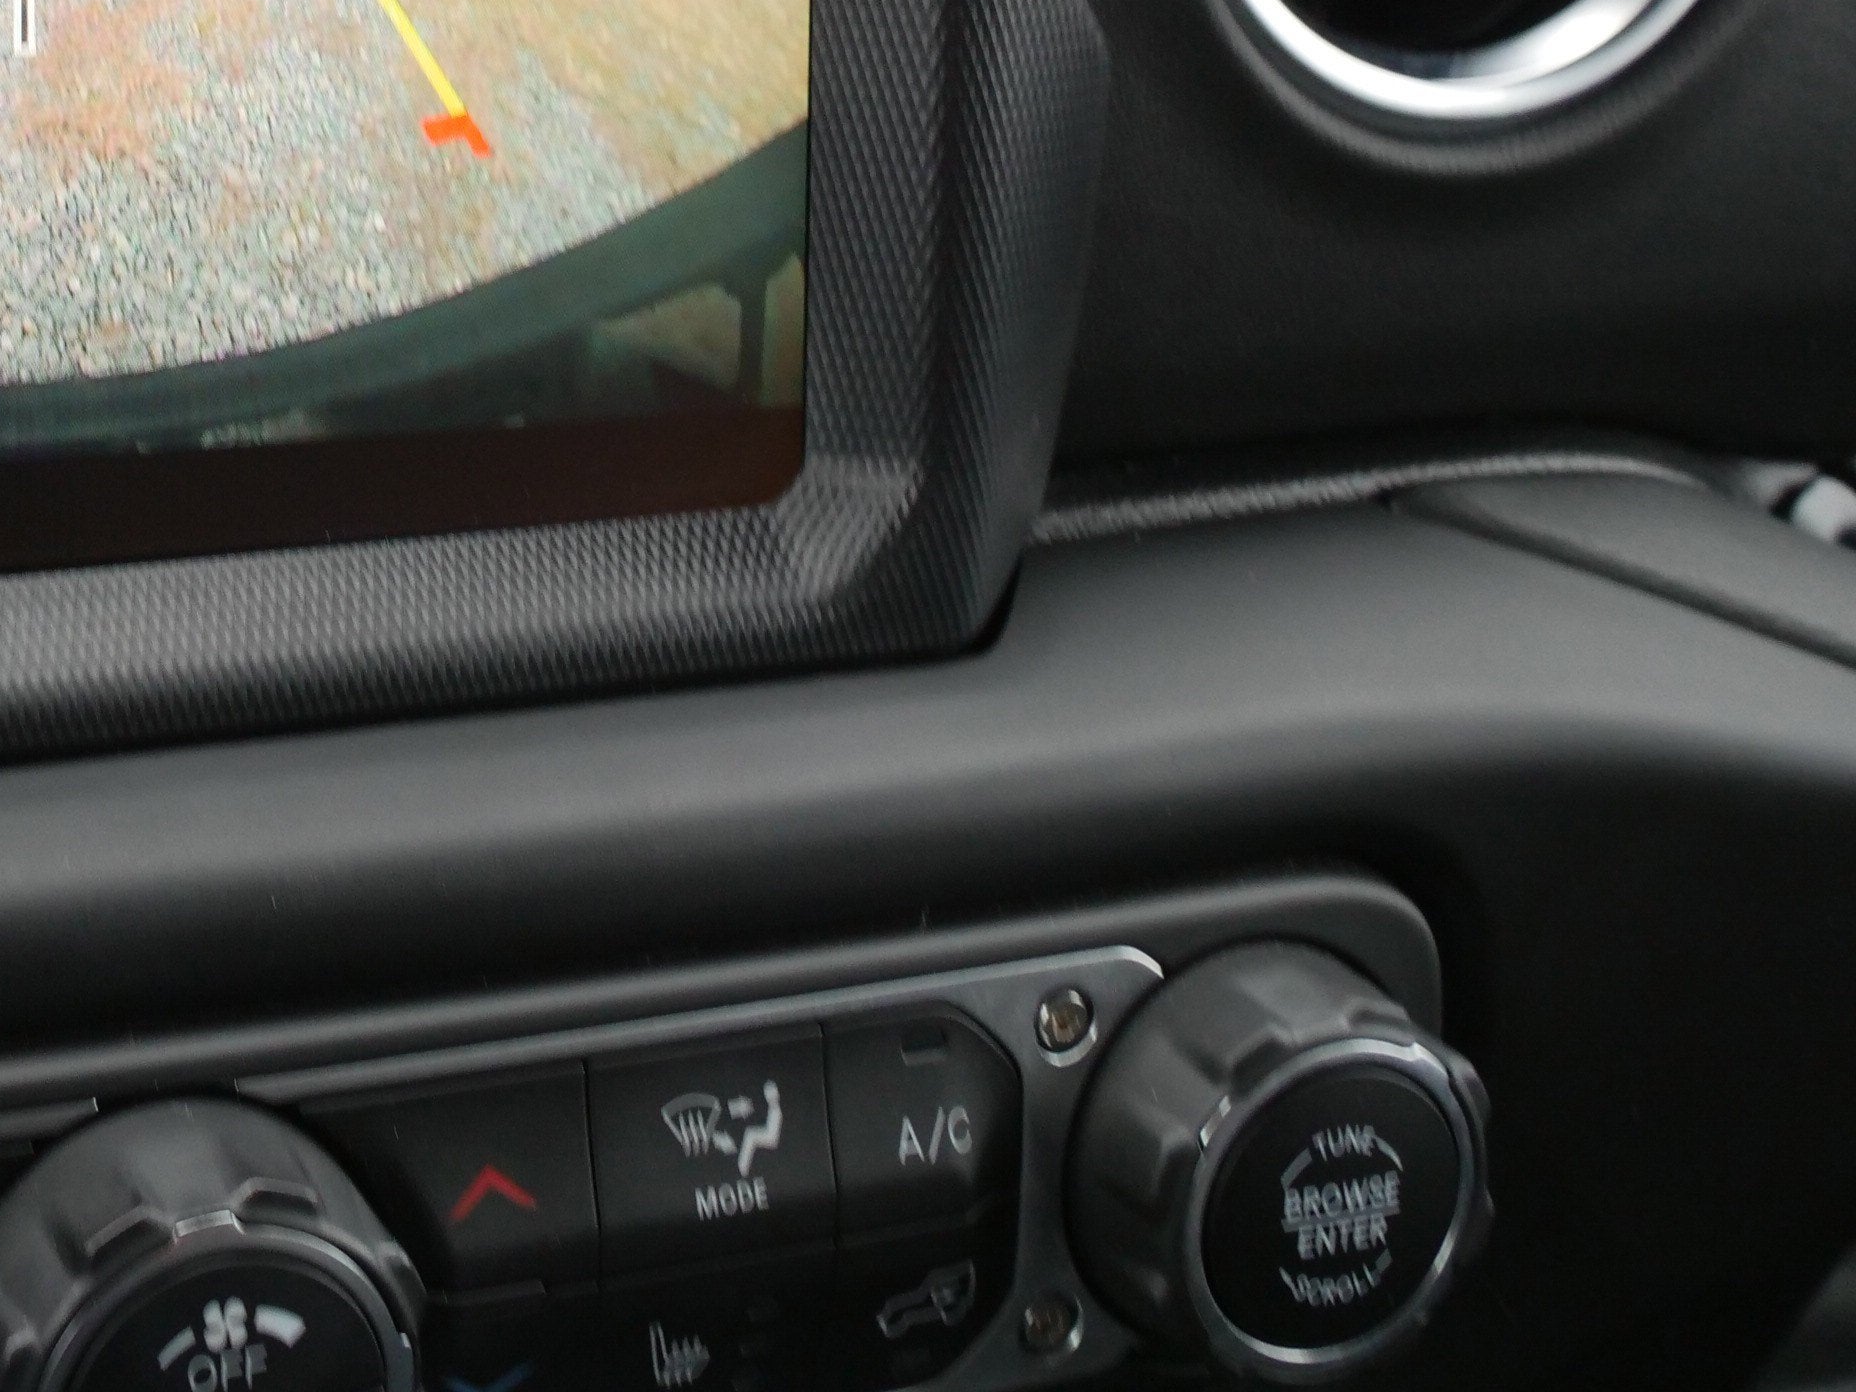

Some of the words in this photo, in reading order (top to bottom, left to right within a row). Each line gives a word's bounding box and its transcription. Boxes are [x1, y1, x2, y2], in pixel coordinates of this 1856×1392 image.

[897, 1106, 972, 1166] A/C
[694, 1176, 770, 1221] MODE
[1283, 1170, 1400, 1225] BROWSE
[1297, 1215, 1387, 1259] ENTER
[187, 1343, 269, 1392] OFF
